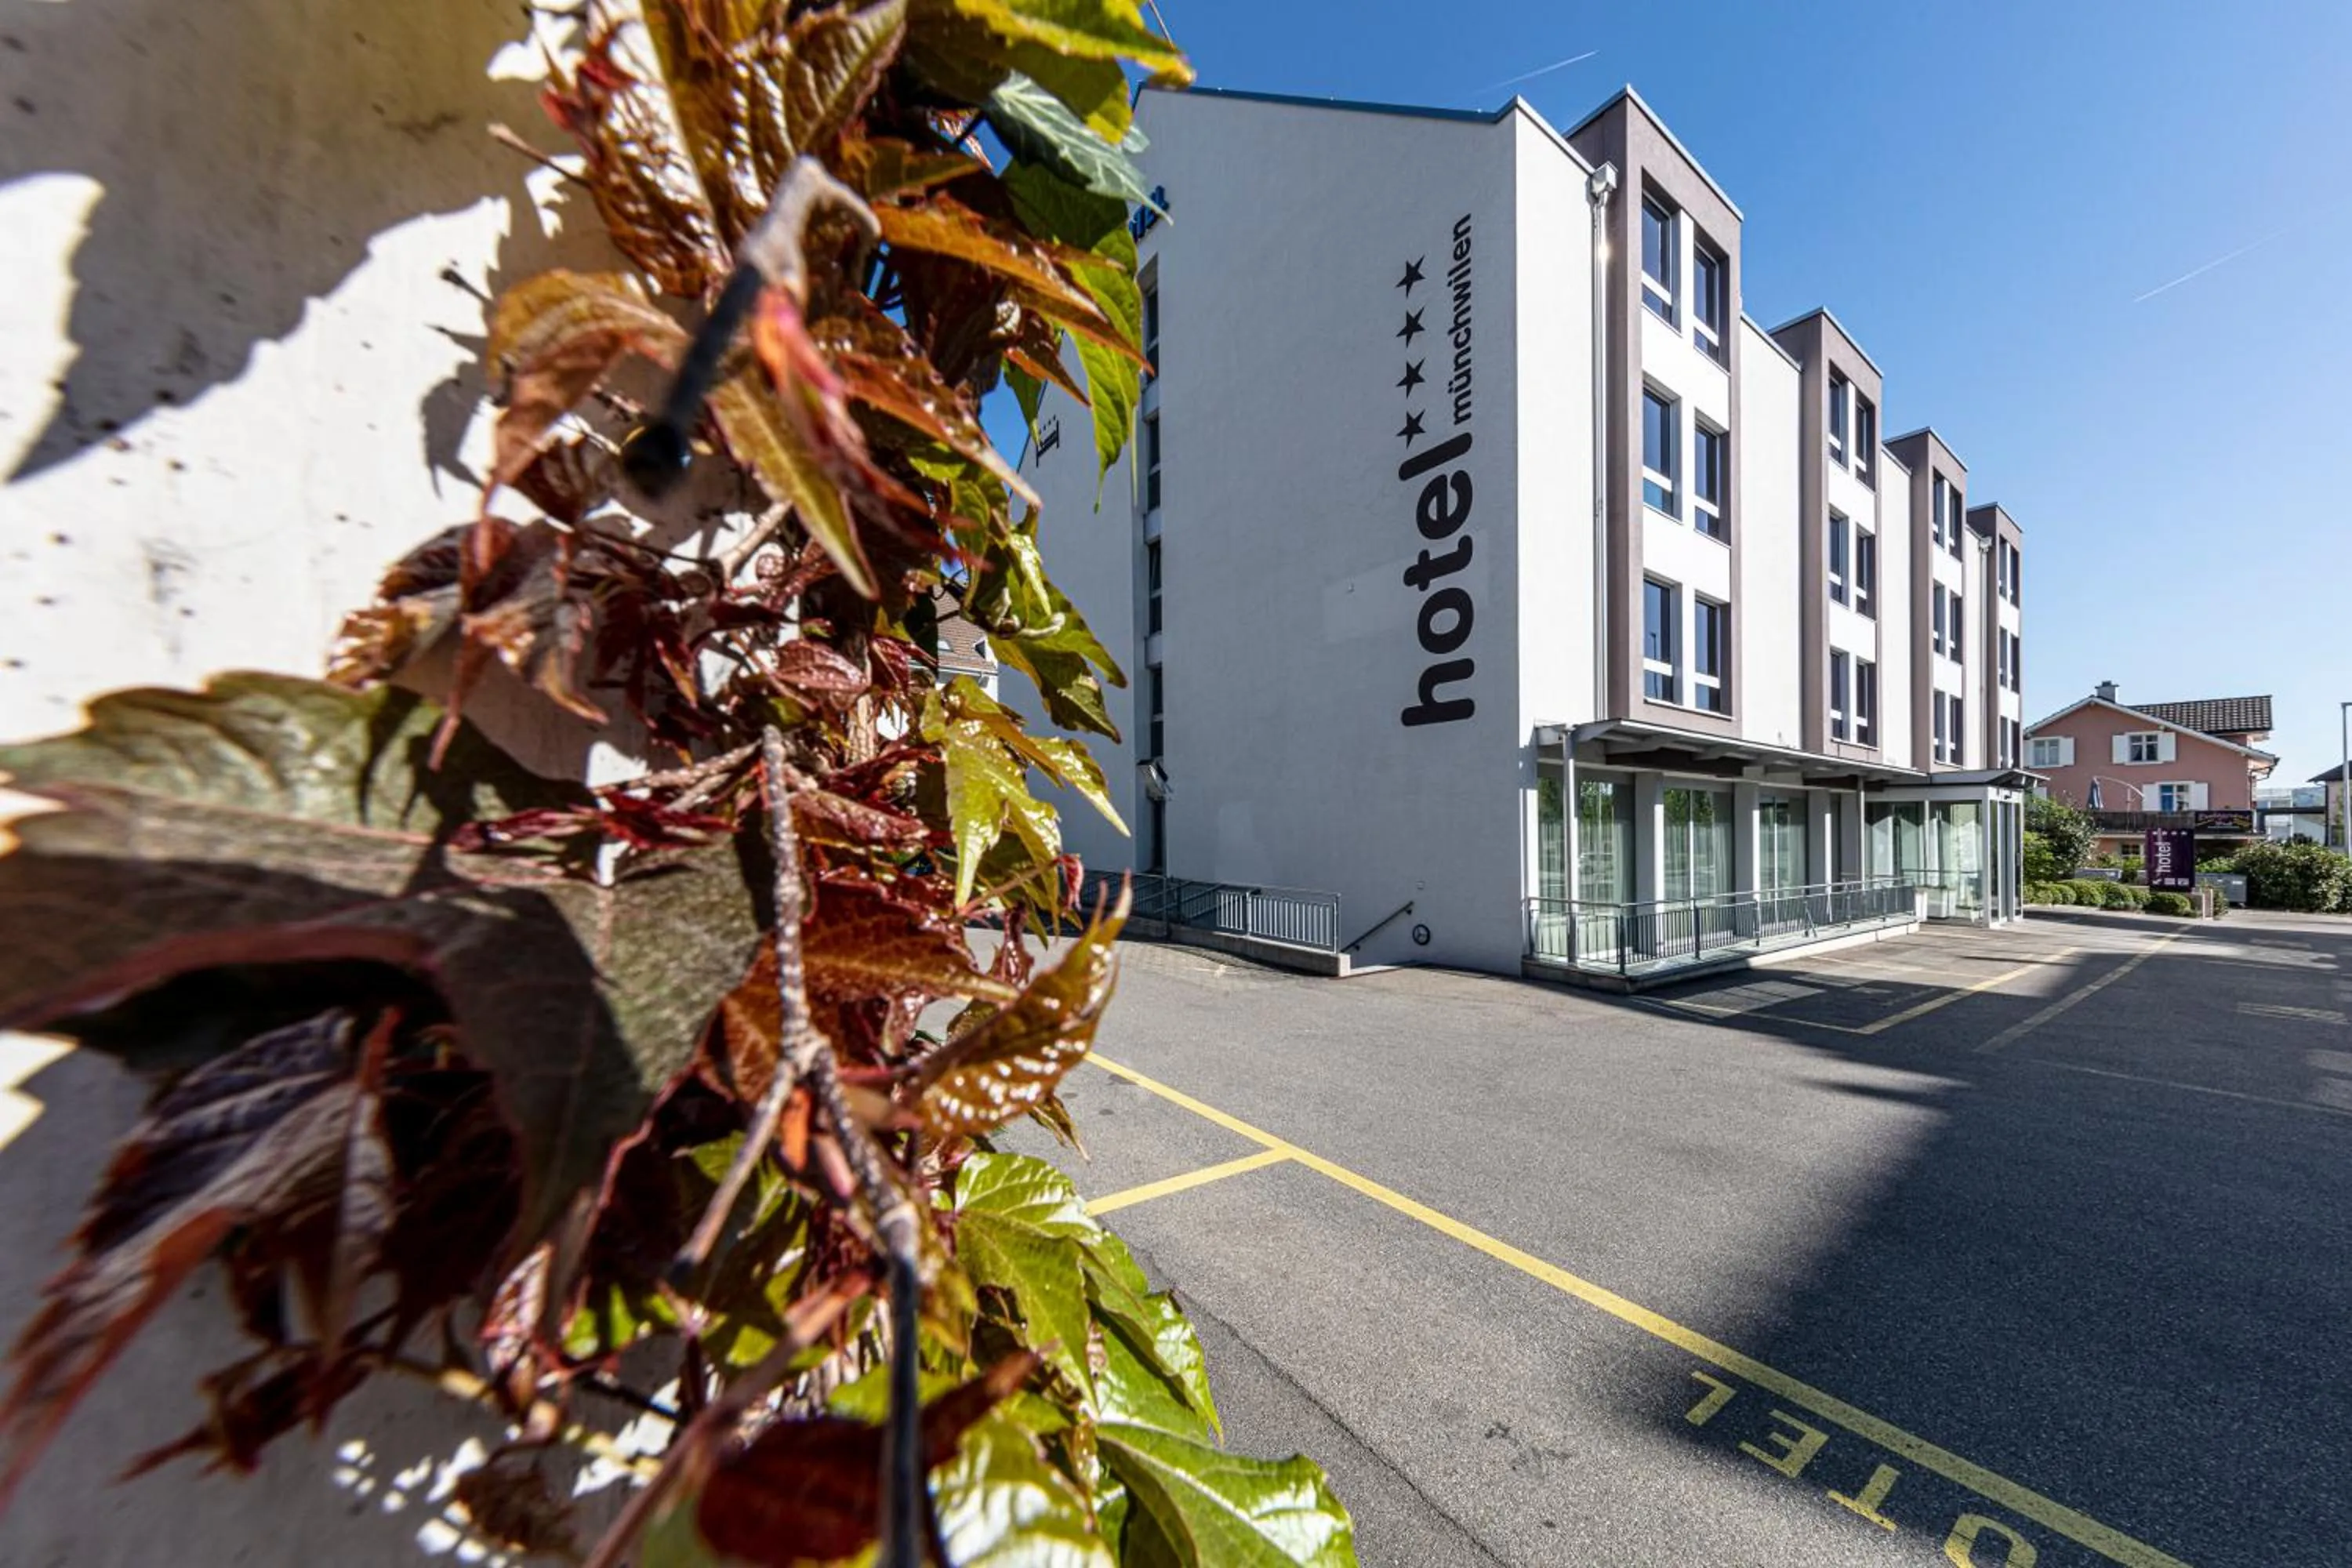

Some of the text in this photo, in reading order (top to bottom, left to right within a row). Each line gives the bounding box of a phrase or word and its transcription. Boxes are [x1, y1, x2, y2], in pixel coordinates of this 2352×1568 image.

[1399, 213, 1475, 727] hotel münchwilen
[2154, 841, 2171, 872] hotel
